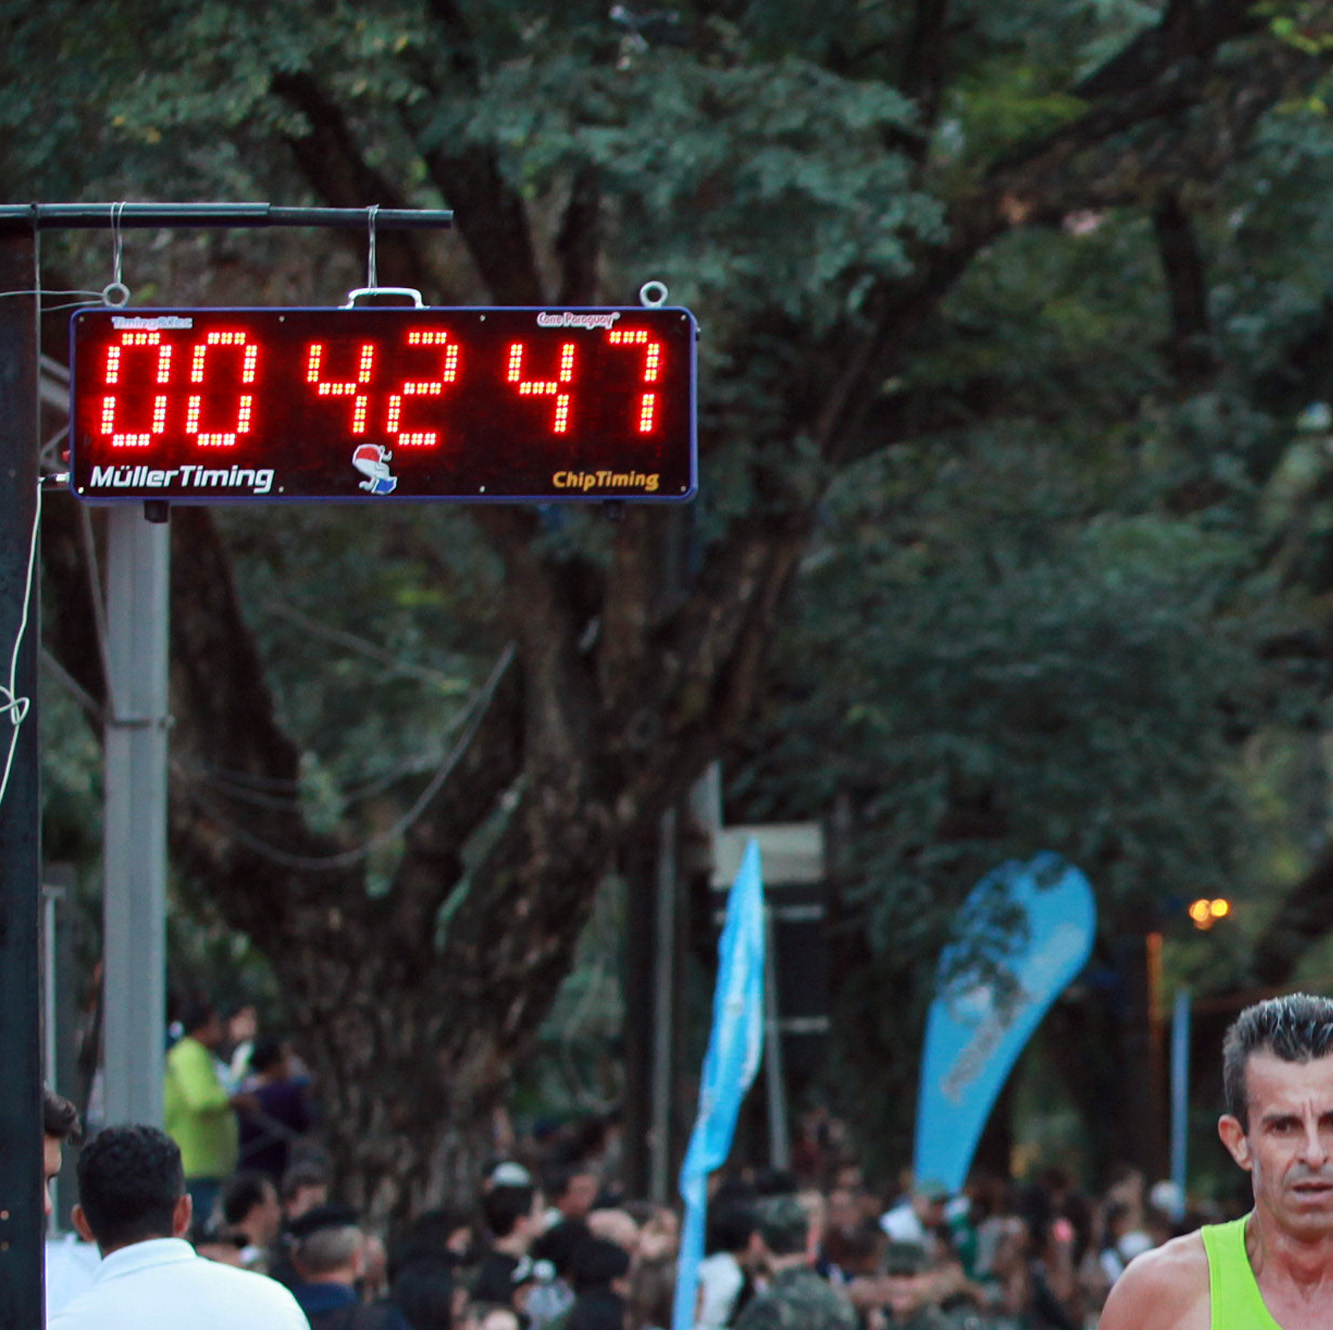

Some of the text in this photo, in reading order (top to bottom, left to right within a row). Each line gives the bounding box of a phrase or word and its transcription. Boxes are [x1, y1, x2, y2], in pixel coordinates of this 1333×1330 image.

[101, 331, 660, 447] 00 42 47
[553, 470, 660, 491] ChipTiming
